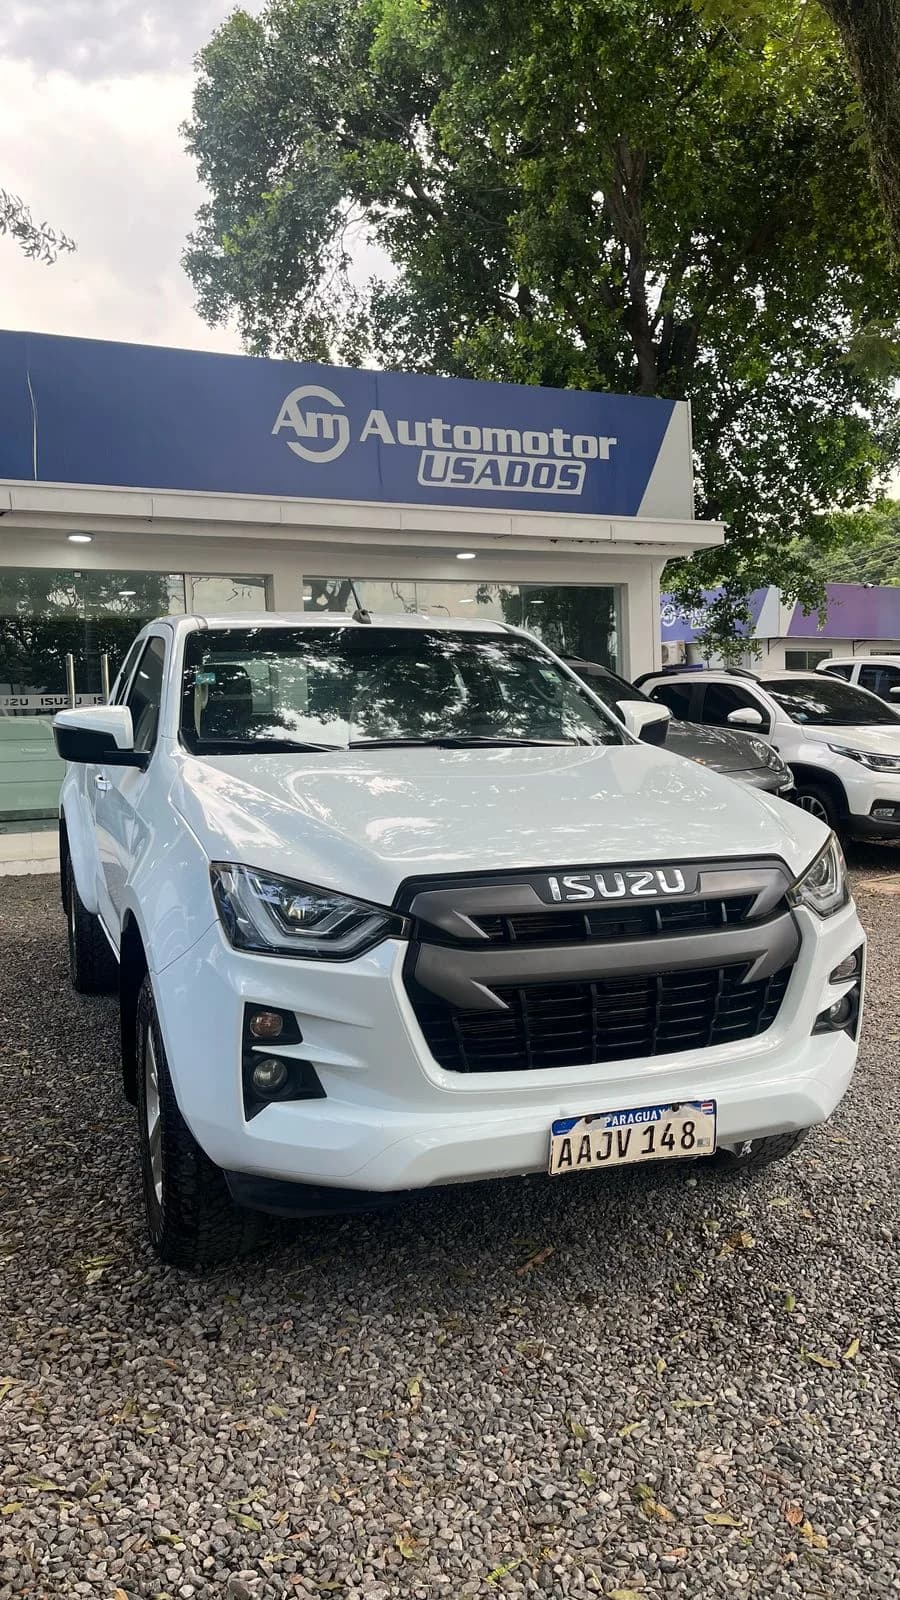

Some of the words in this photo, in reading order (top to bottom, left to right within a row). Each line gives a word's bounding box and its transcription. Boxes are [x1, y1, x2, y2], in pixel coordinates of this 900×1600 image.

[359, 409, 617, 460] Automotor
[422, 454, 583, 491] USADOS
[548, 869, 686, 902] ISUZU
[604, 1109, 666, 1128] PARAGUAY
[557, 1128, 632, 1169] AAJV
[641, 1121, 695, 1155] 148
